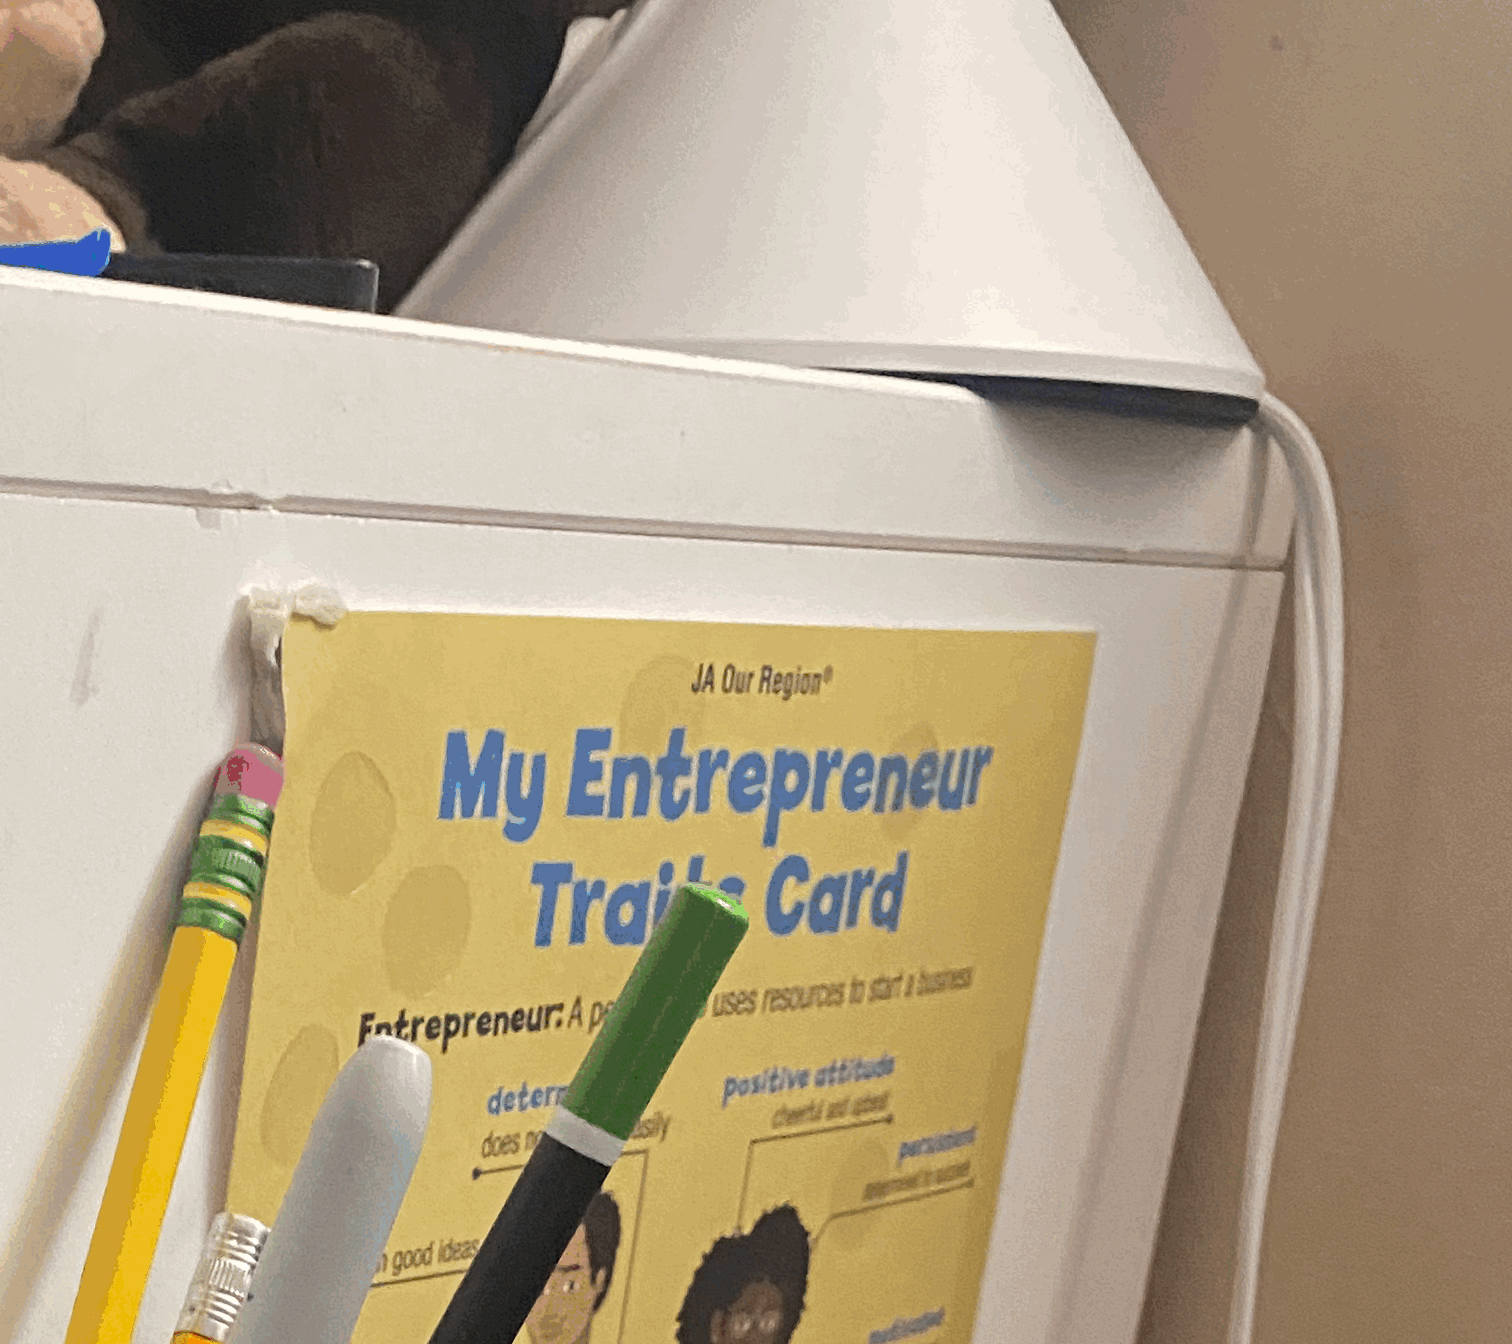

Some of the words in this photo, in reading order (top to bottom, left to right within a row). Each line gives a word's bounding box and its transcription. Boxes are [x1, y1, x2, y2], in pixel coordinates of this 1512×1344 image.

[690, 662, 715, 695] JA
[721, 662, 755, 694] Our
[437, 728, 547, 843] My
[566, 727, 995, 848] Entrepreneur
[764, 850, 910, 938] Card
[567, 995, 584, 1029] A
[712, 990, 757, 1018] uses
[761, 981, 846, 1014] resources
[721, 1064, 810, 1110] positive
[814, 1052, 896, 1088] attitude
[481, 1130, 522, 1158] does
[391, 1239, 435, 1277] good
